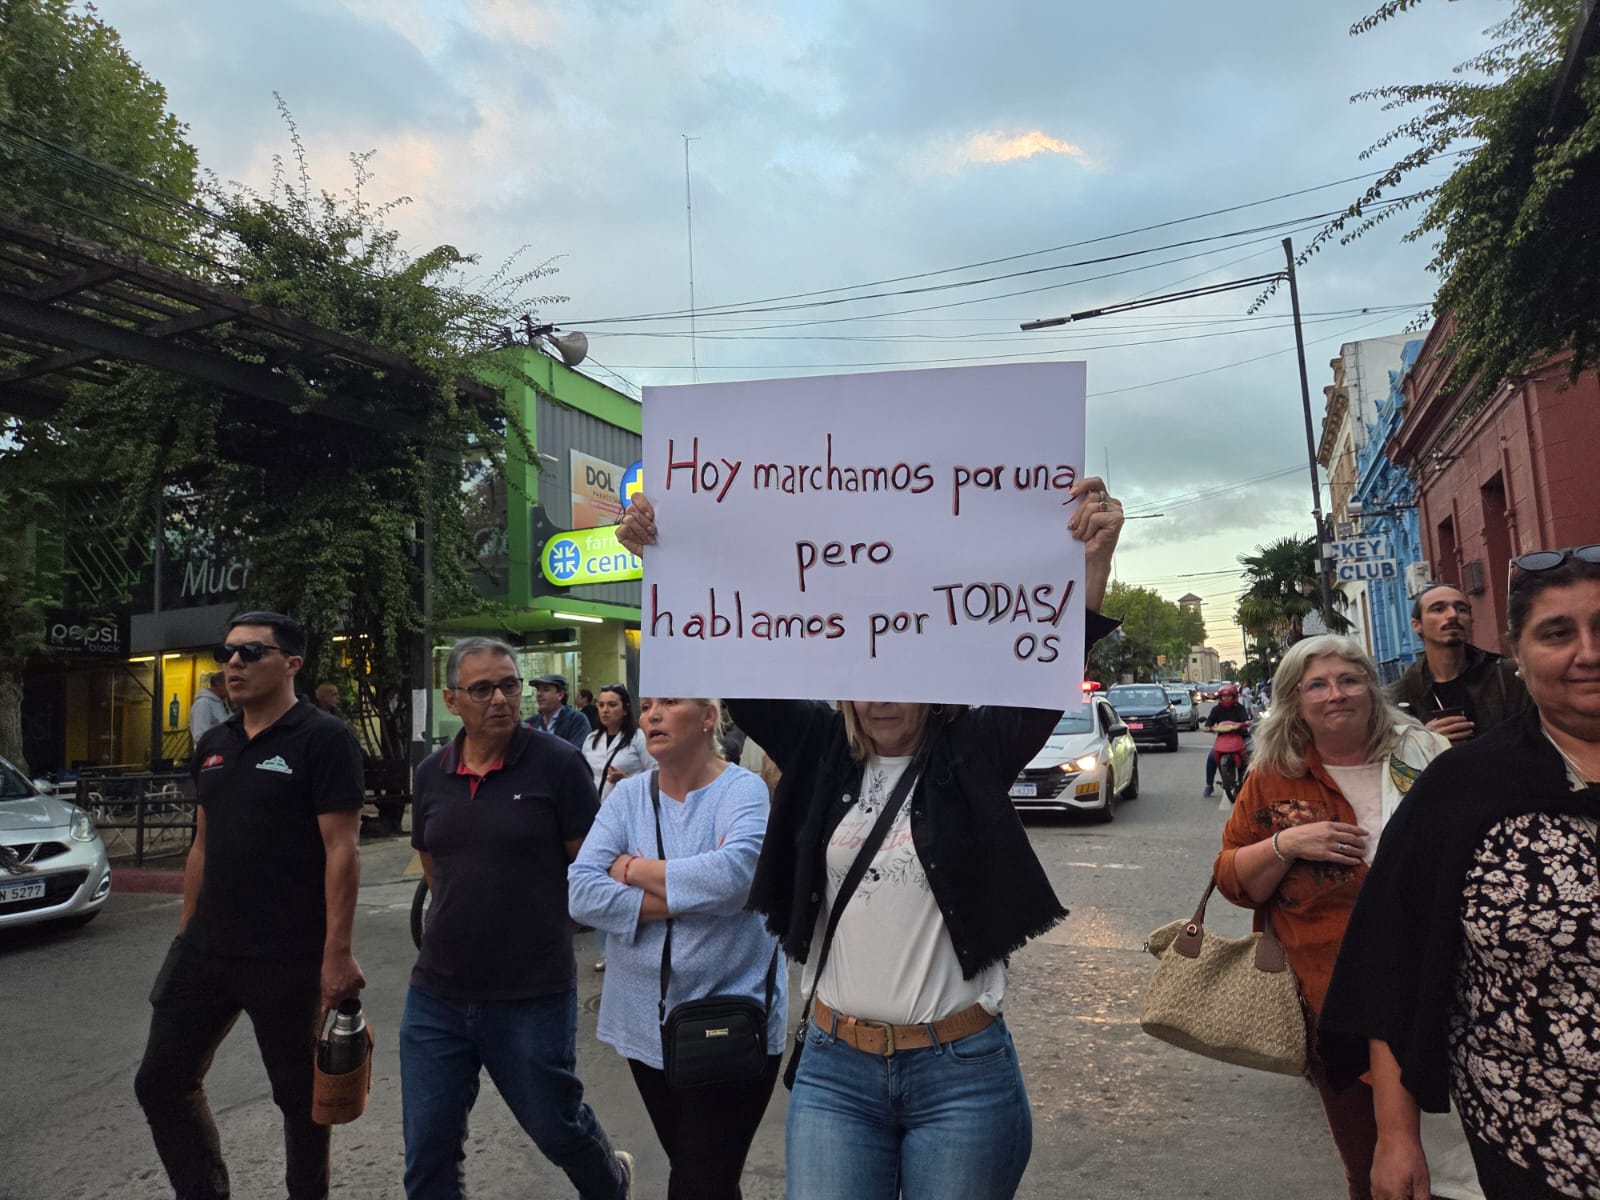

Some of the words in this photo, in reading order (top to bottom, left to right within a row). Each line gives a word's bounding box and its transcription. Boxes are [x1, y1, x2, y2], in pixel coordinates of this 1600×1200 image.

[586, 465, 615, 493] DOL
[667, 435, 742, 503] Hoy
[754, 433, 934, 493] marchamos
[953, 464, 1005, 517] por
[796, 541, 893, 593] pero
[1340, 562, 1395, 581] CLUB
[649, 583, 846, 641] hablamos
[869, 612, 930, 658] por
[932, 579, 1075, 628] TODAS/
[88, 640, 120, 653] black
[11, 884, 42, 900] 5277
